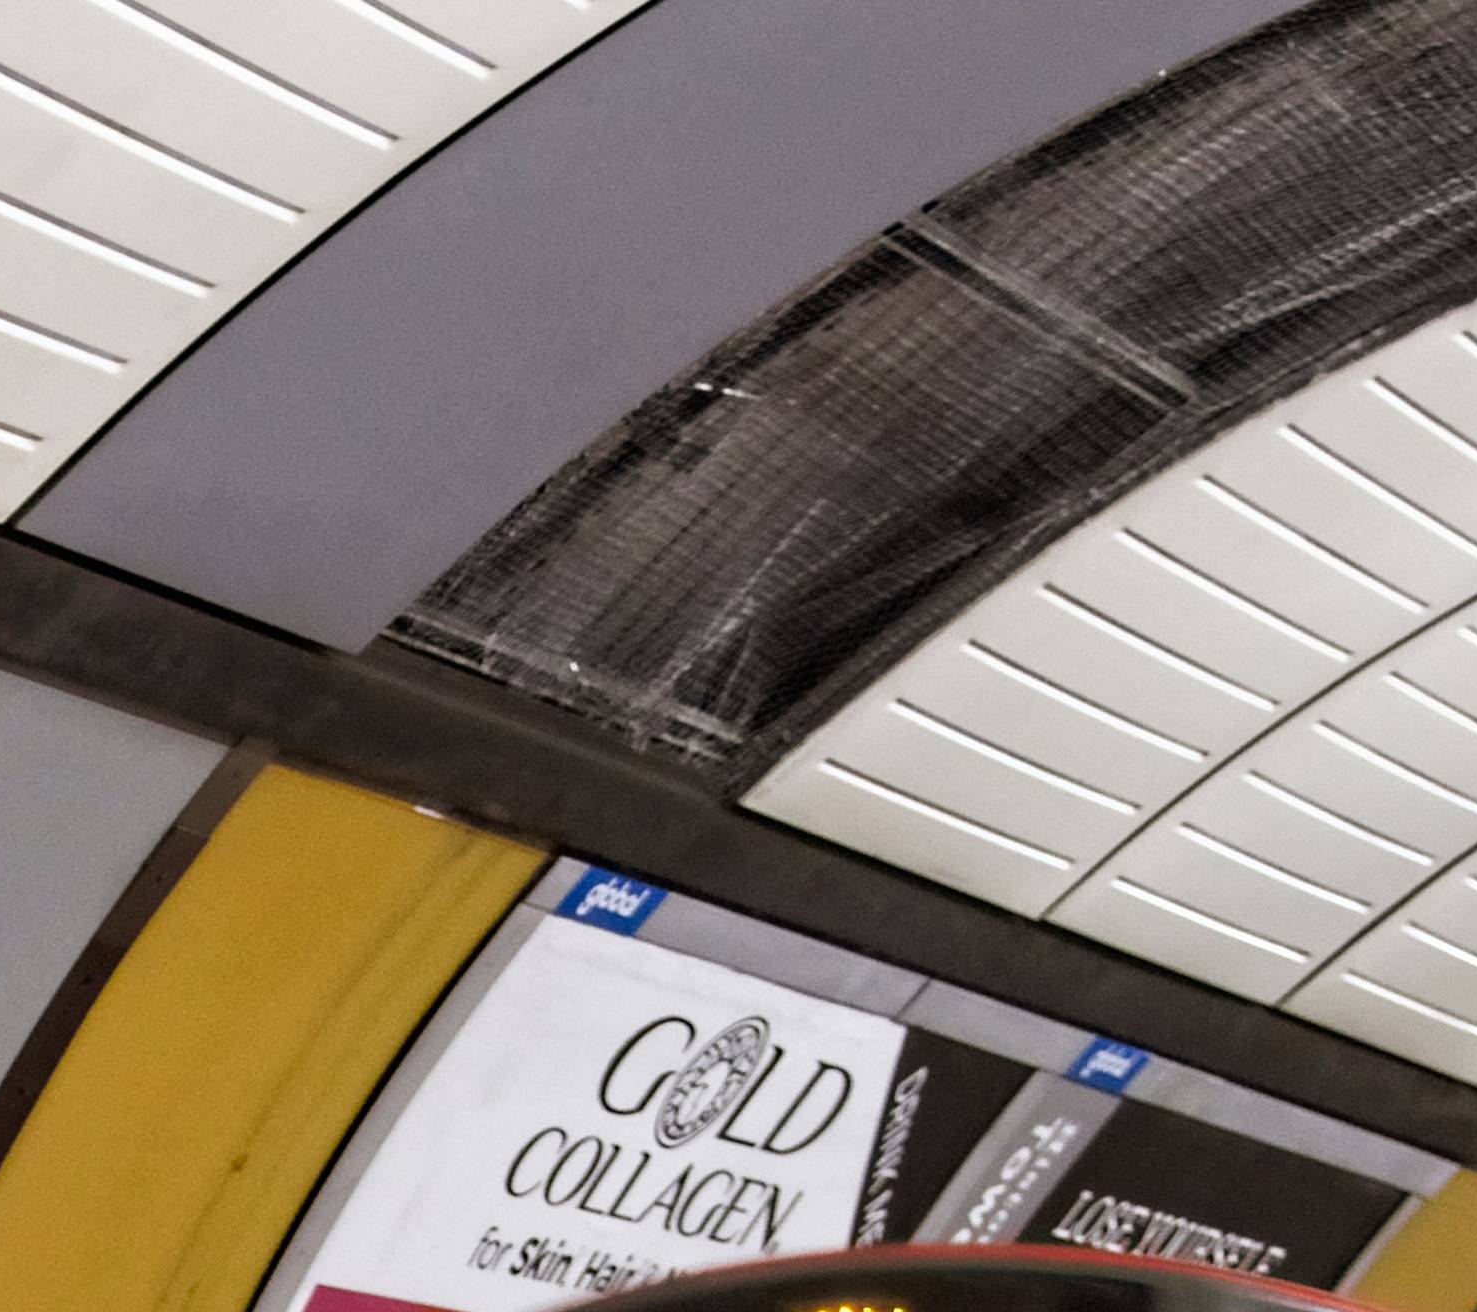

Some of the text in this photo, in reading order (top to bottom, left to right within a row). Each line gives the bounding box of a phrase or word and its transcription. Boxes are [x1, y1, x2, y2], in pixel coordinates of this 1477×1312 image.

[575, 876, 652, 918] global
[504, 1126, 804, 1251] COLLAGEN
[1051, 1189, 1150, 1254] LOSE
[467, 1226, 513, 1270] for
[575, 1249, 637, 1293] Hair
